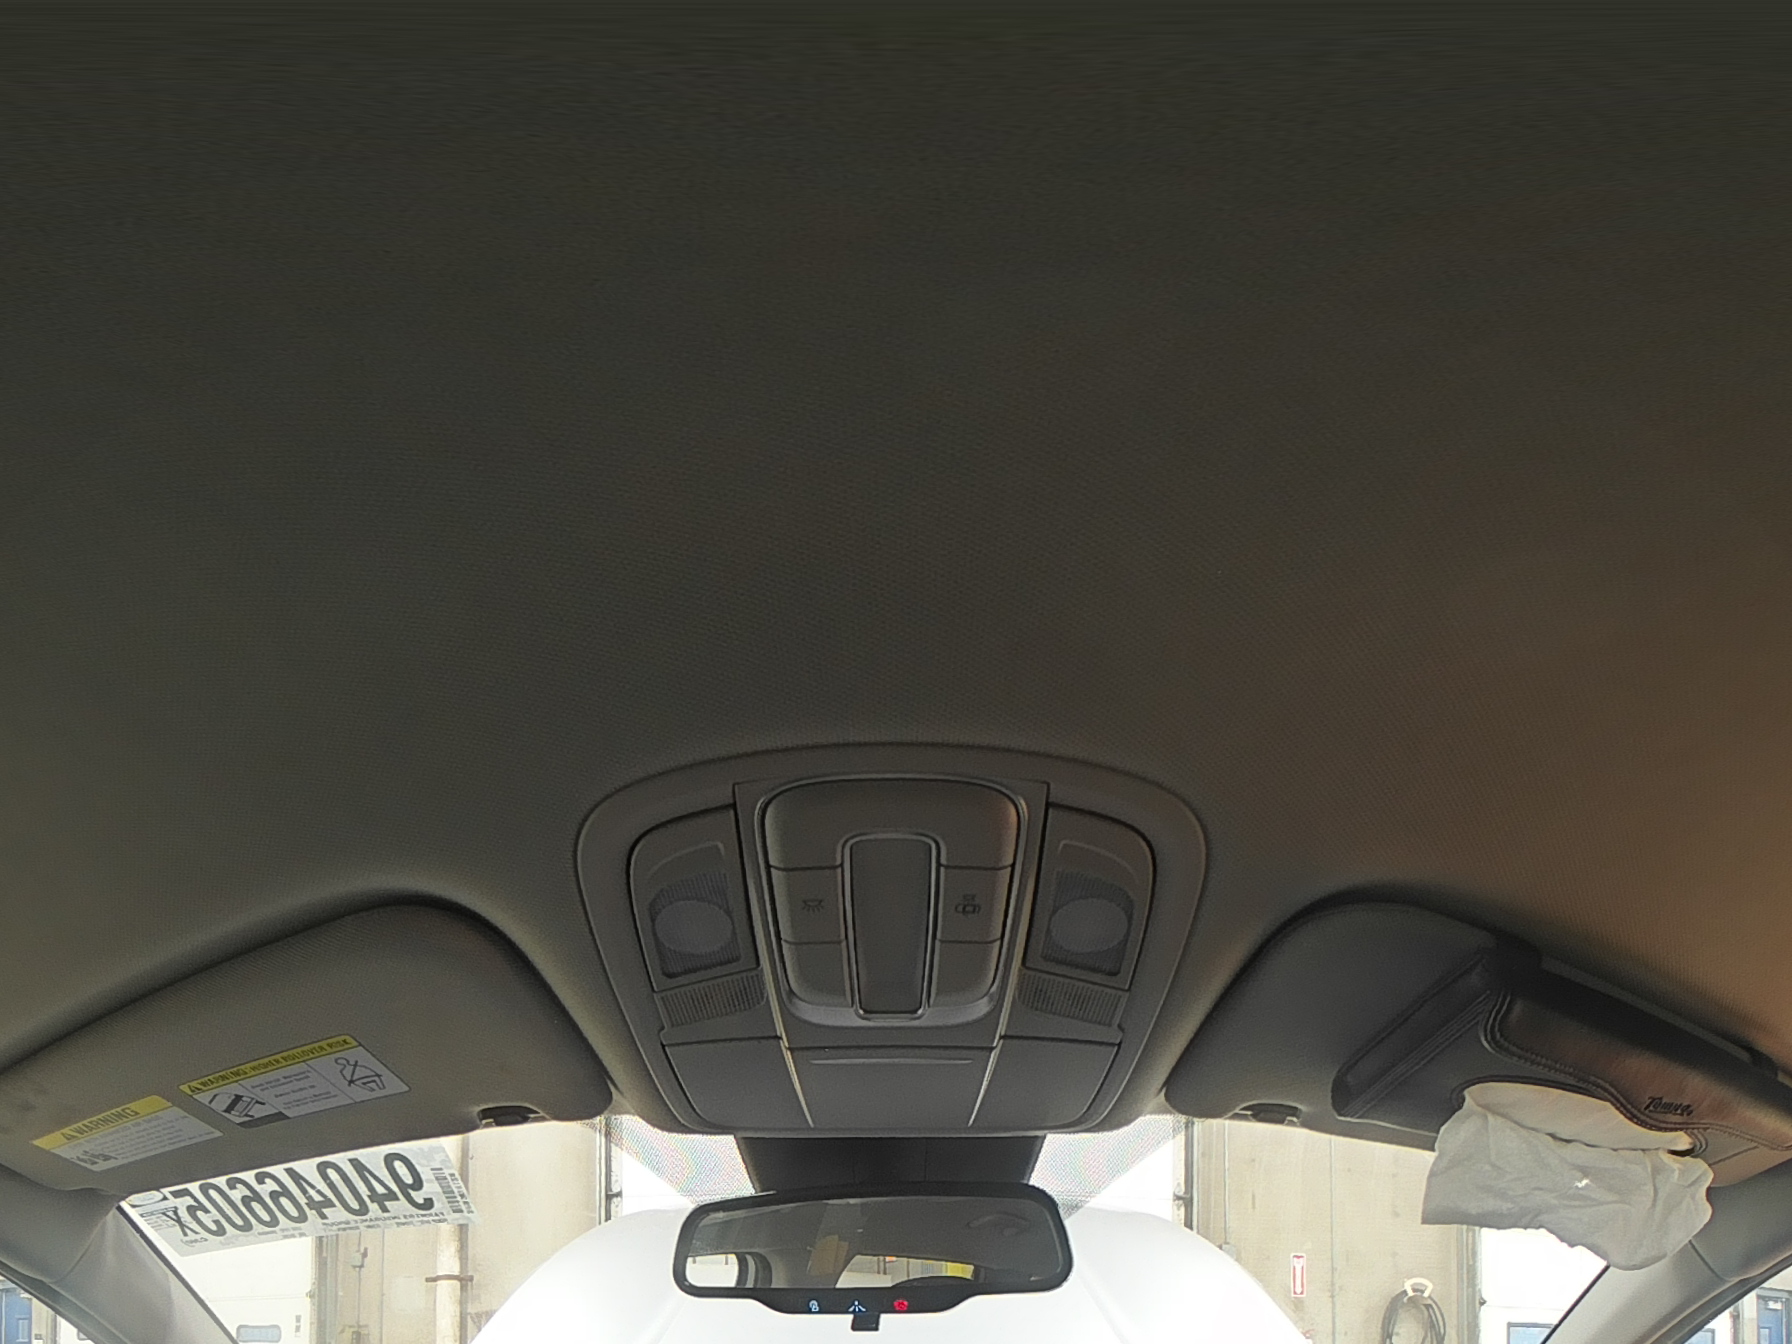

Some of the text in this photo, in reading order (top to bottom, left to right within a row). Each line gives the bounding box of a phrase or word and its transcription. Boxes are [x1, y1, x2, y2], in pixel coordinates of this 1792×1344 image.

[249, 1056, 282, 1074] HIGHER
[281, 1043, 326, 1067] ROLLOVER
[327, 1038, 355, 1053] RISK
[74, 1106, 141, 1137] WARNING
